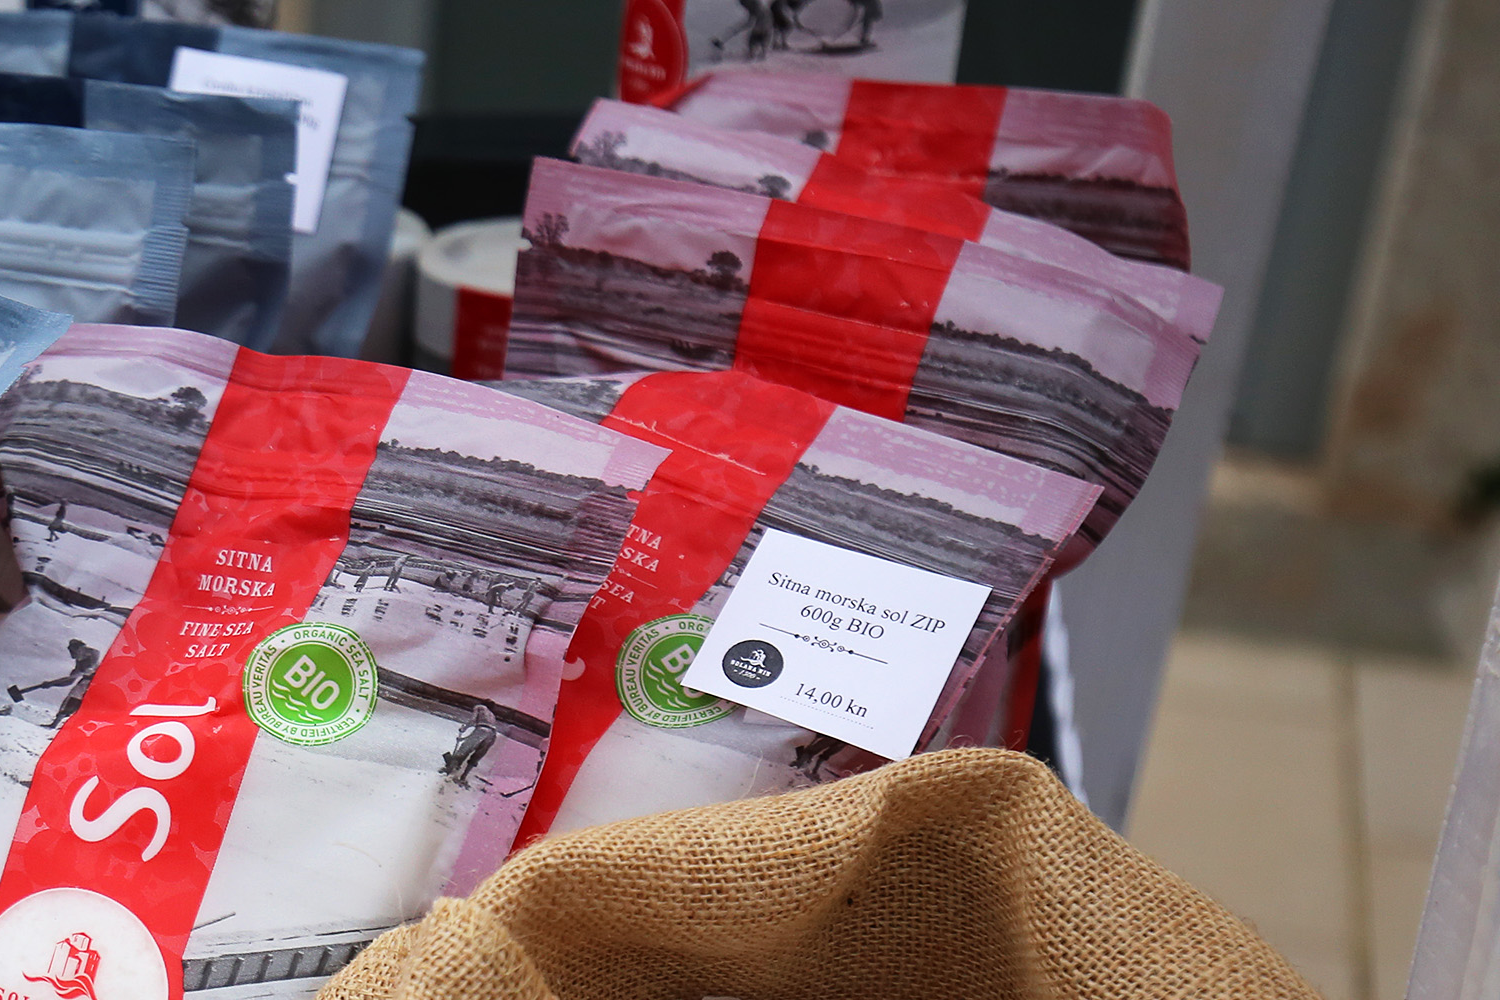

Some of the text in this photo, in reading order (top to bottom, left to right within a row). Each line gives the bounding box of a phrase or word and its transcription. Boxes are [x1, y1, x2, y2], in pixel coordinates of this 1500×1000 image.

[626, 524, 663, 550] TNA
[215, 549, 273, 573] SITNA
[620, 547, 660, 573] SKA
[198, 574, 276, 597] MORSKA
[768, 572, 946, 633] Sitna morska sol ZIP
[179, 621, 254, 637] FINE SEA
[800, 605, 885, 639] 600g BIO
[185, 643, 230, 658] SALT
[293, 629, 369, 700] ORGANIC SEA SALT
[623, 629, 659, 670] VERITAS
[252, 644, 355, 738] CERTIFIED BY BUREAU VERITAS
[283, 654, 340, 710] BIO
[625, 671, 648, 713] BUREAU
[645, 708, 659, 720] BY
[662, 705, 723, 723] CERTIFIED
[795, 683, 868, 718] 14,00 kn
[69, 696, 217, 862] Sol
